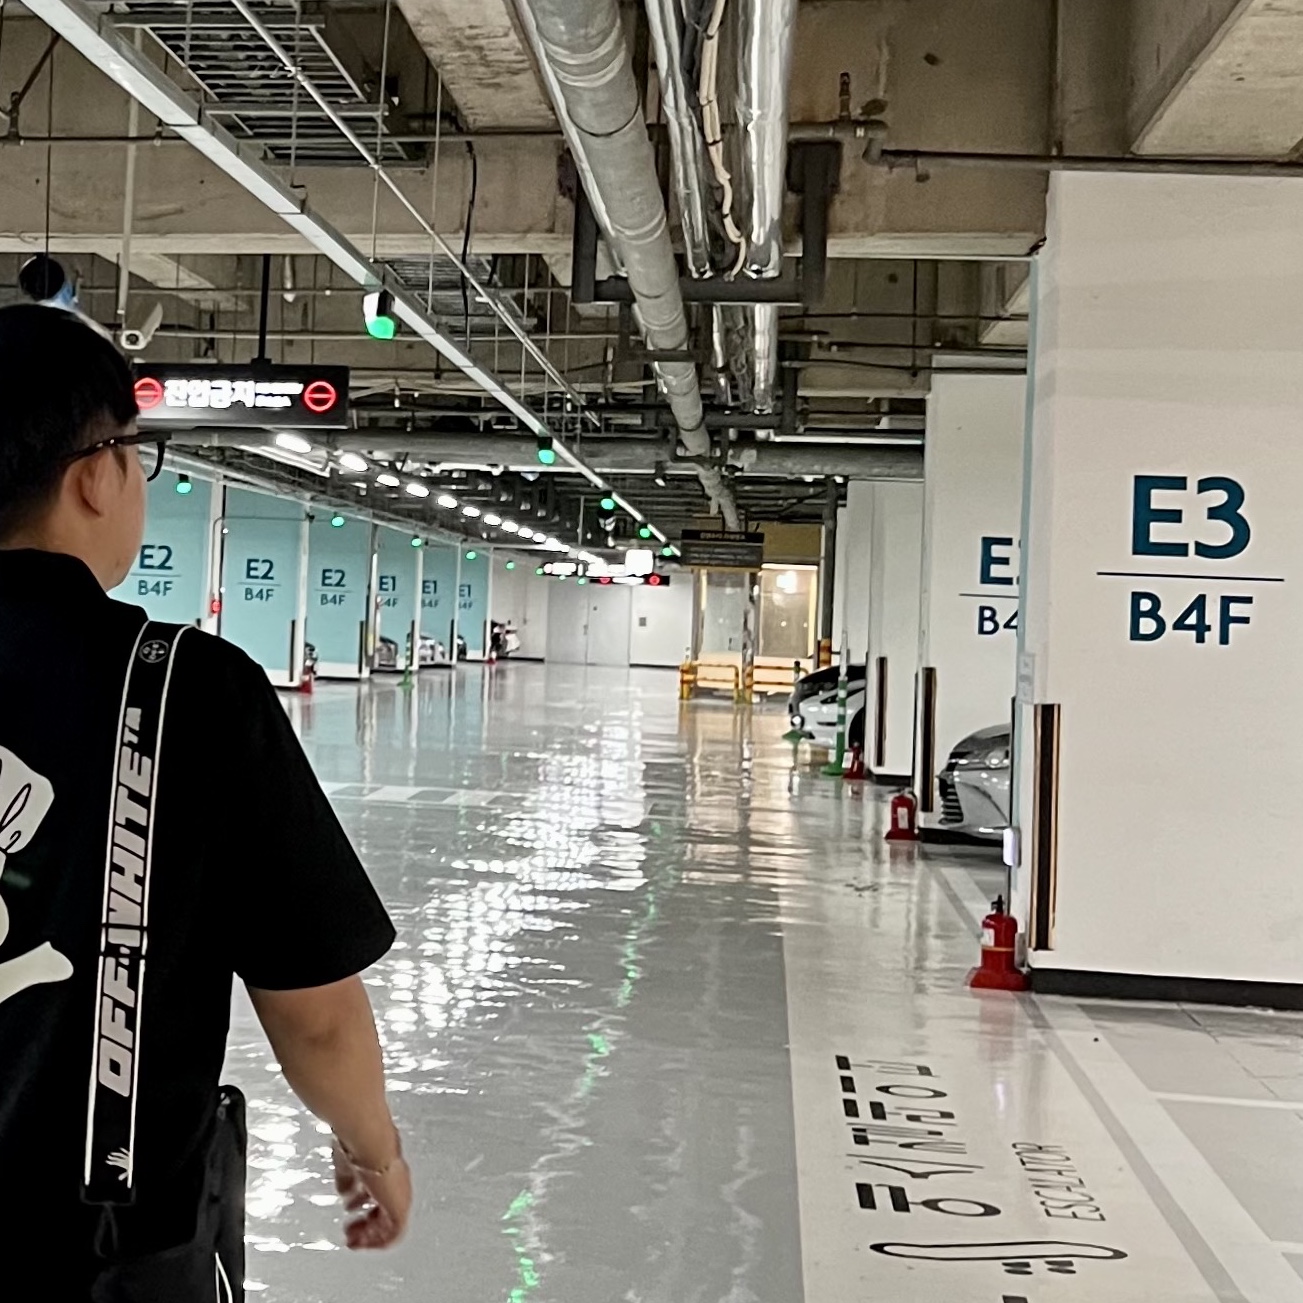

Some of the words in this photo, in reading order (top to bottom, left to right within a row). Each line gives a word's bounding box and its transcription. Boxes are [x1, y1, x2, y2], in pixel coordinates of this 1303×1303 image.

[1131, 474, 1253, 560] E3
[139, 544, 173, 570] E2
[979, 536, 1021, 586] E
[246, 558, 275, 581] E2
[321, 568, 347, 588] E2
[137, 579, 174, 597] B4F
[244, 587, 275, 602] B4F
[379, 575, 397, 592] E1
[422, 580, 438, 595] E1
[320, 593, 347, 607] B4F
[978, 605, 1018, 635] B4
[1129, 591, 1255, 646] B4F
[1011, 1141, 1107, 1222] ESCALATOR
